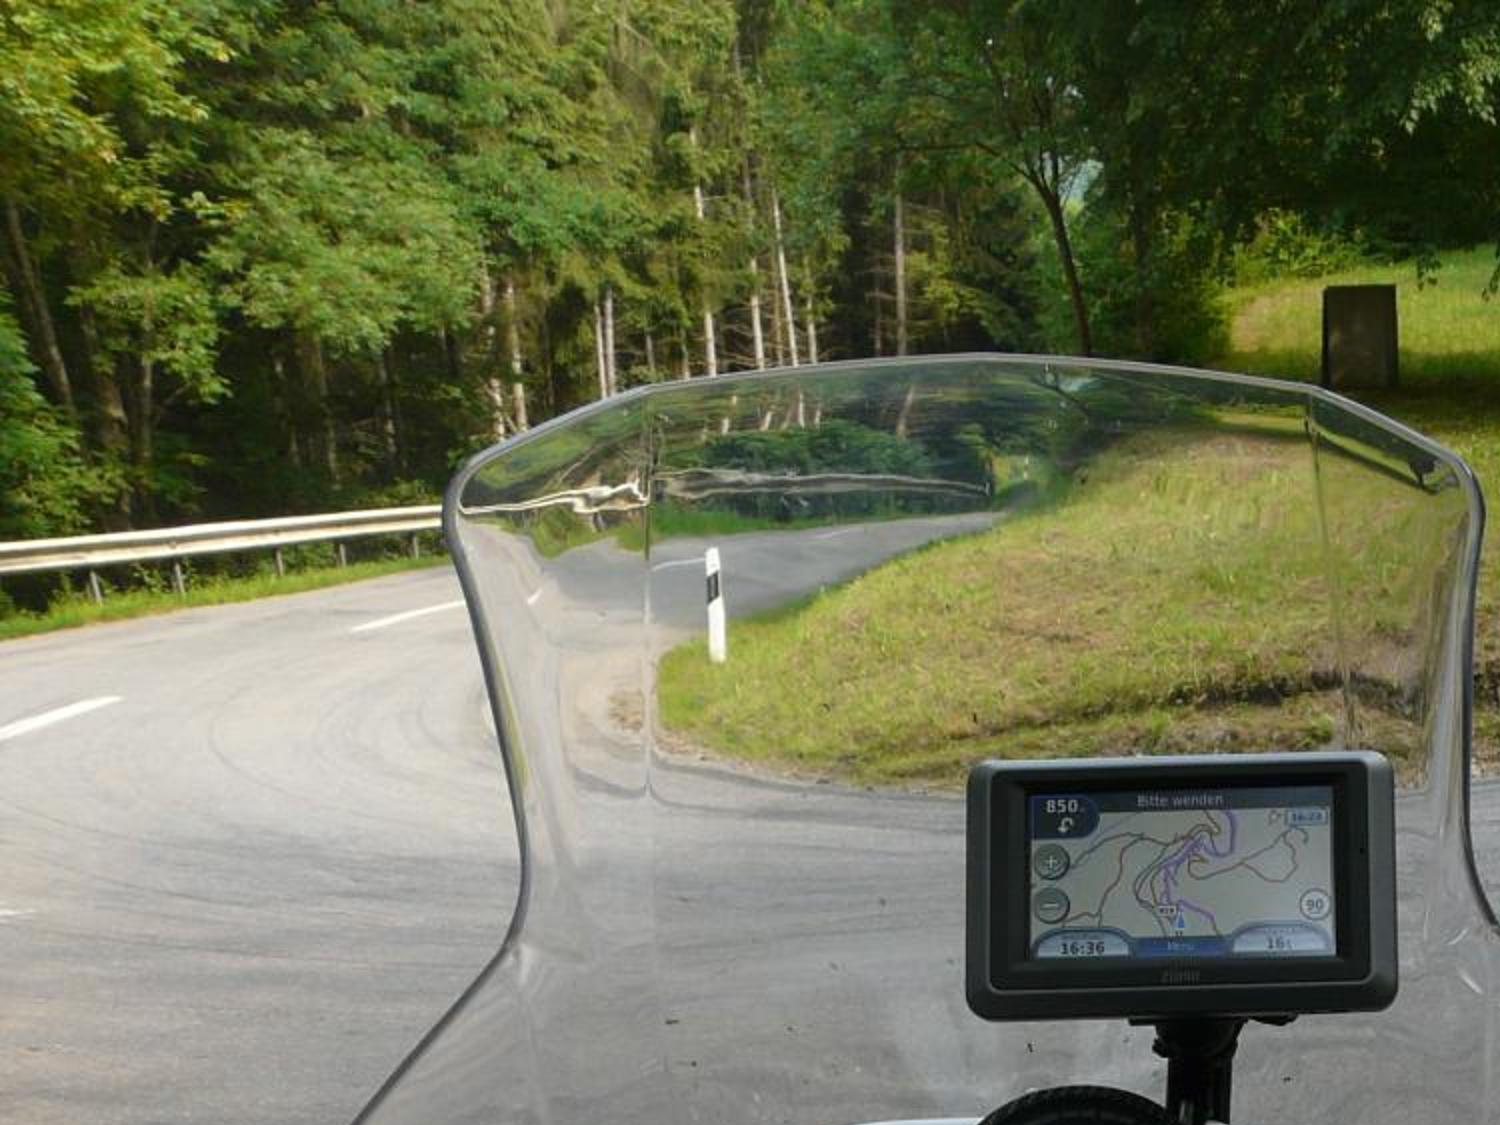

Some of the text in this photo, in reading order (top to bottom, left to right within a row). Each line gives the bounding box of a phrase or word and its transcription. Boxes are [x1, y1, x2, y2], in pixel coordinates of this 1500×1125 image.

[1046, 798, 1079, 813] 850
[1137, 793, 1224, 807] Bitte wenden
[1306, 898, 1324, 911] 90
[1060, 940, 1105, 955] 16:36
